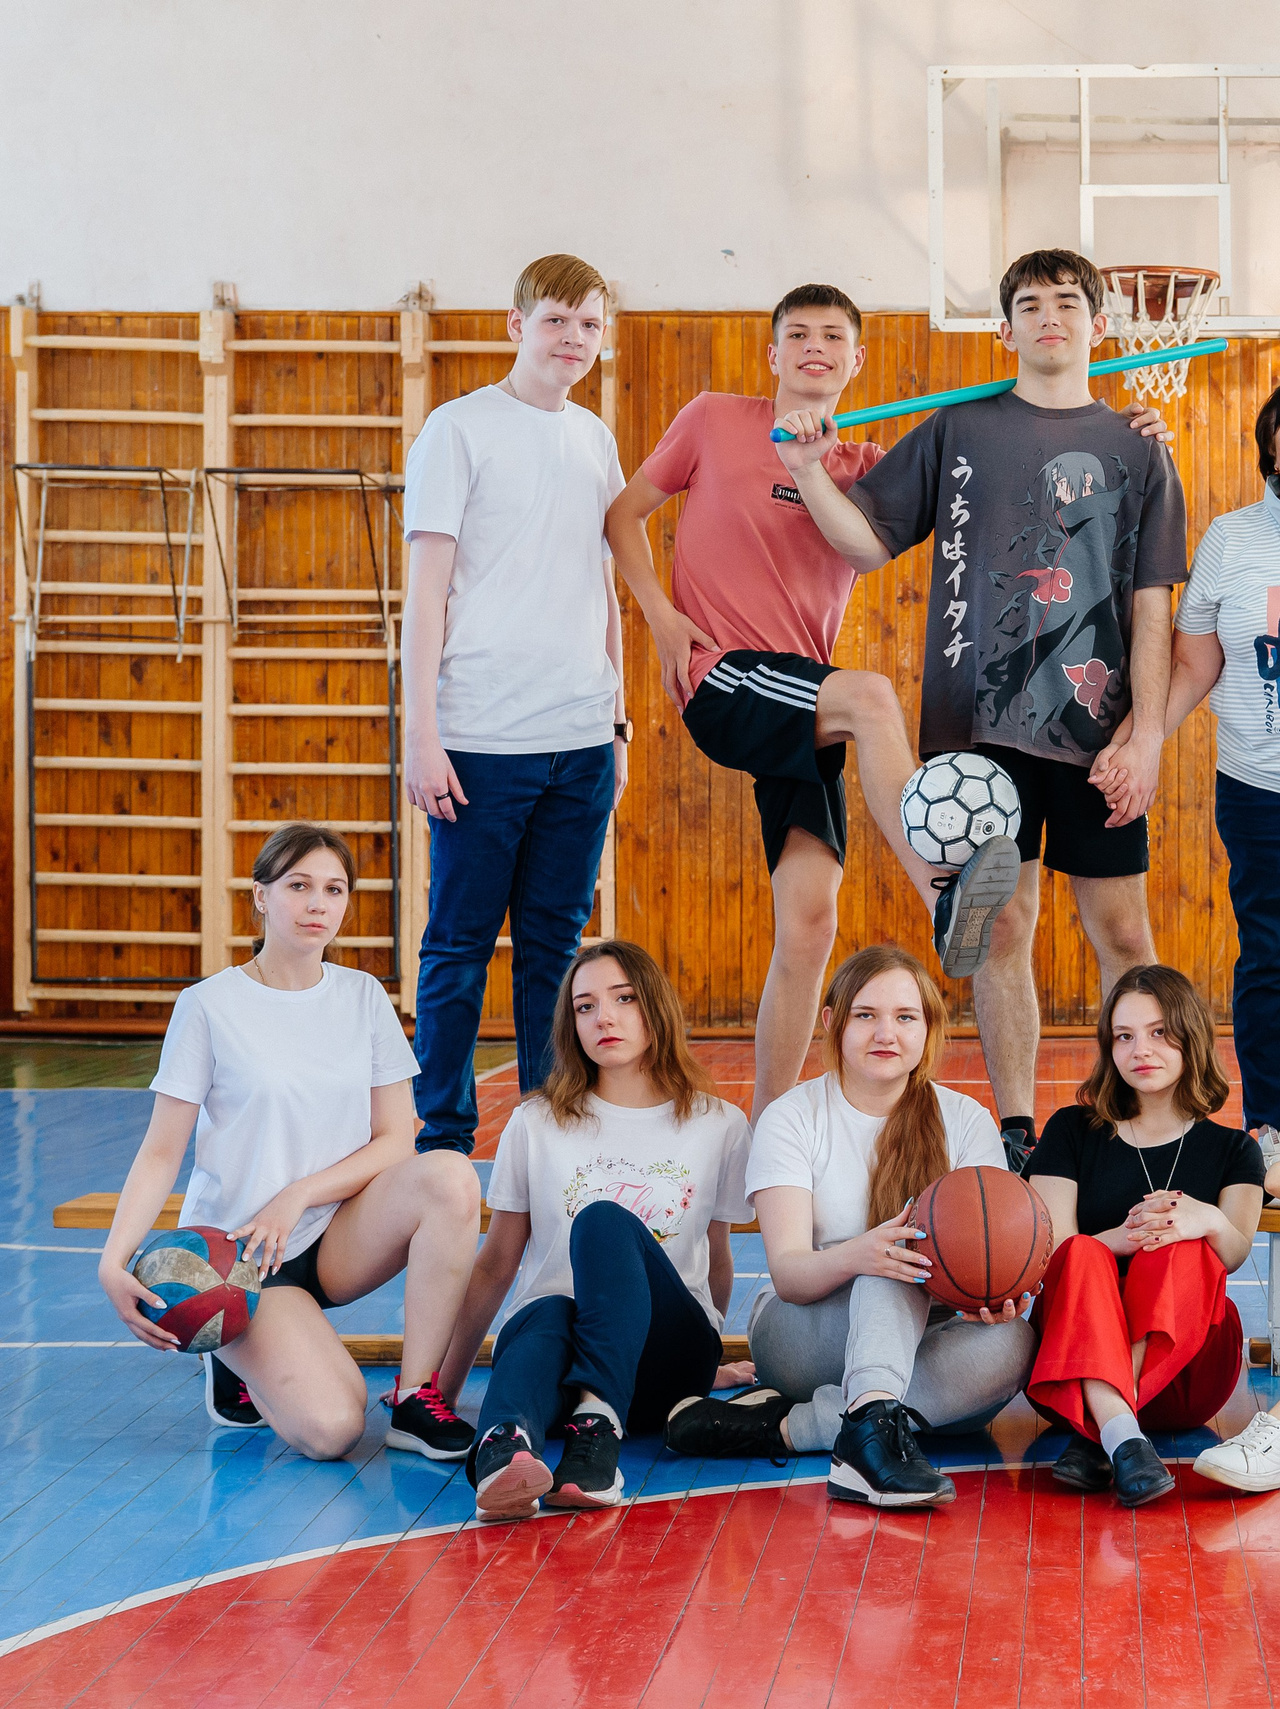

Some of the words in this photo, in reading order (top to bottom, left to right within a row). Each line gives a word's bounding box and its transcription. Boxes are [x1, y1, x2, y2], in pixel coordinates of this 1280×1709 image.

[942, 456, 974, 668] うちはイタチ
